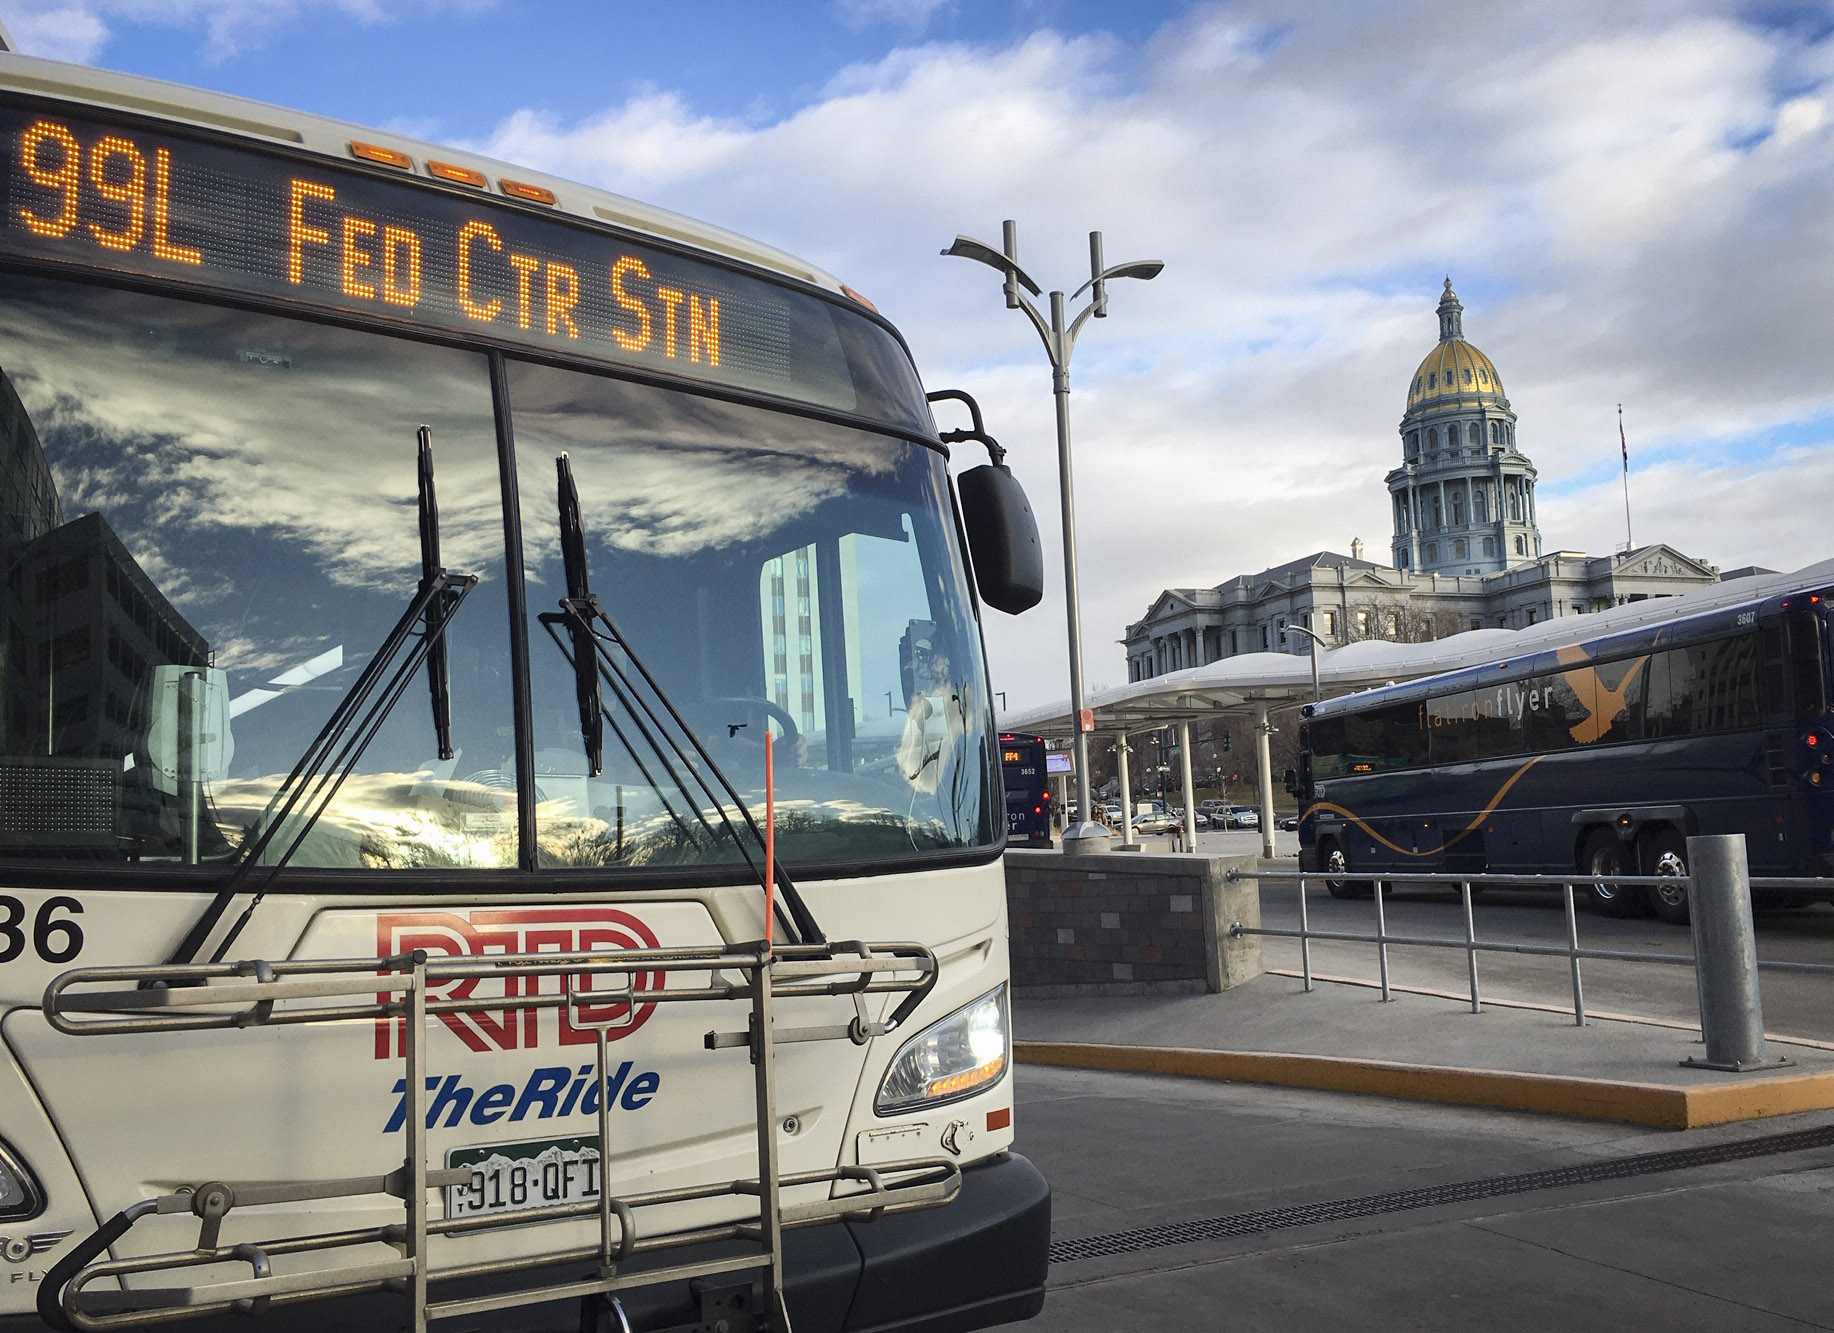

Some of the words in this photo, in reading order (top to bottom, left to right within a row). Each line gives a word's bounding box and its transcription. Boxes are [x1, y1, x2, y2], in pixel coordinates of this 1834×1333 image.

[19, 120, 202, 265] 99L
[1737, 611, 1756, 625] 3607
[1005, 752, 1018, 761] FF4
[375, 908, 666, 1060] RTD
